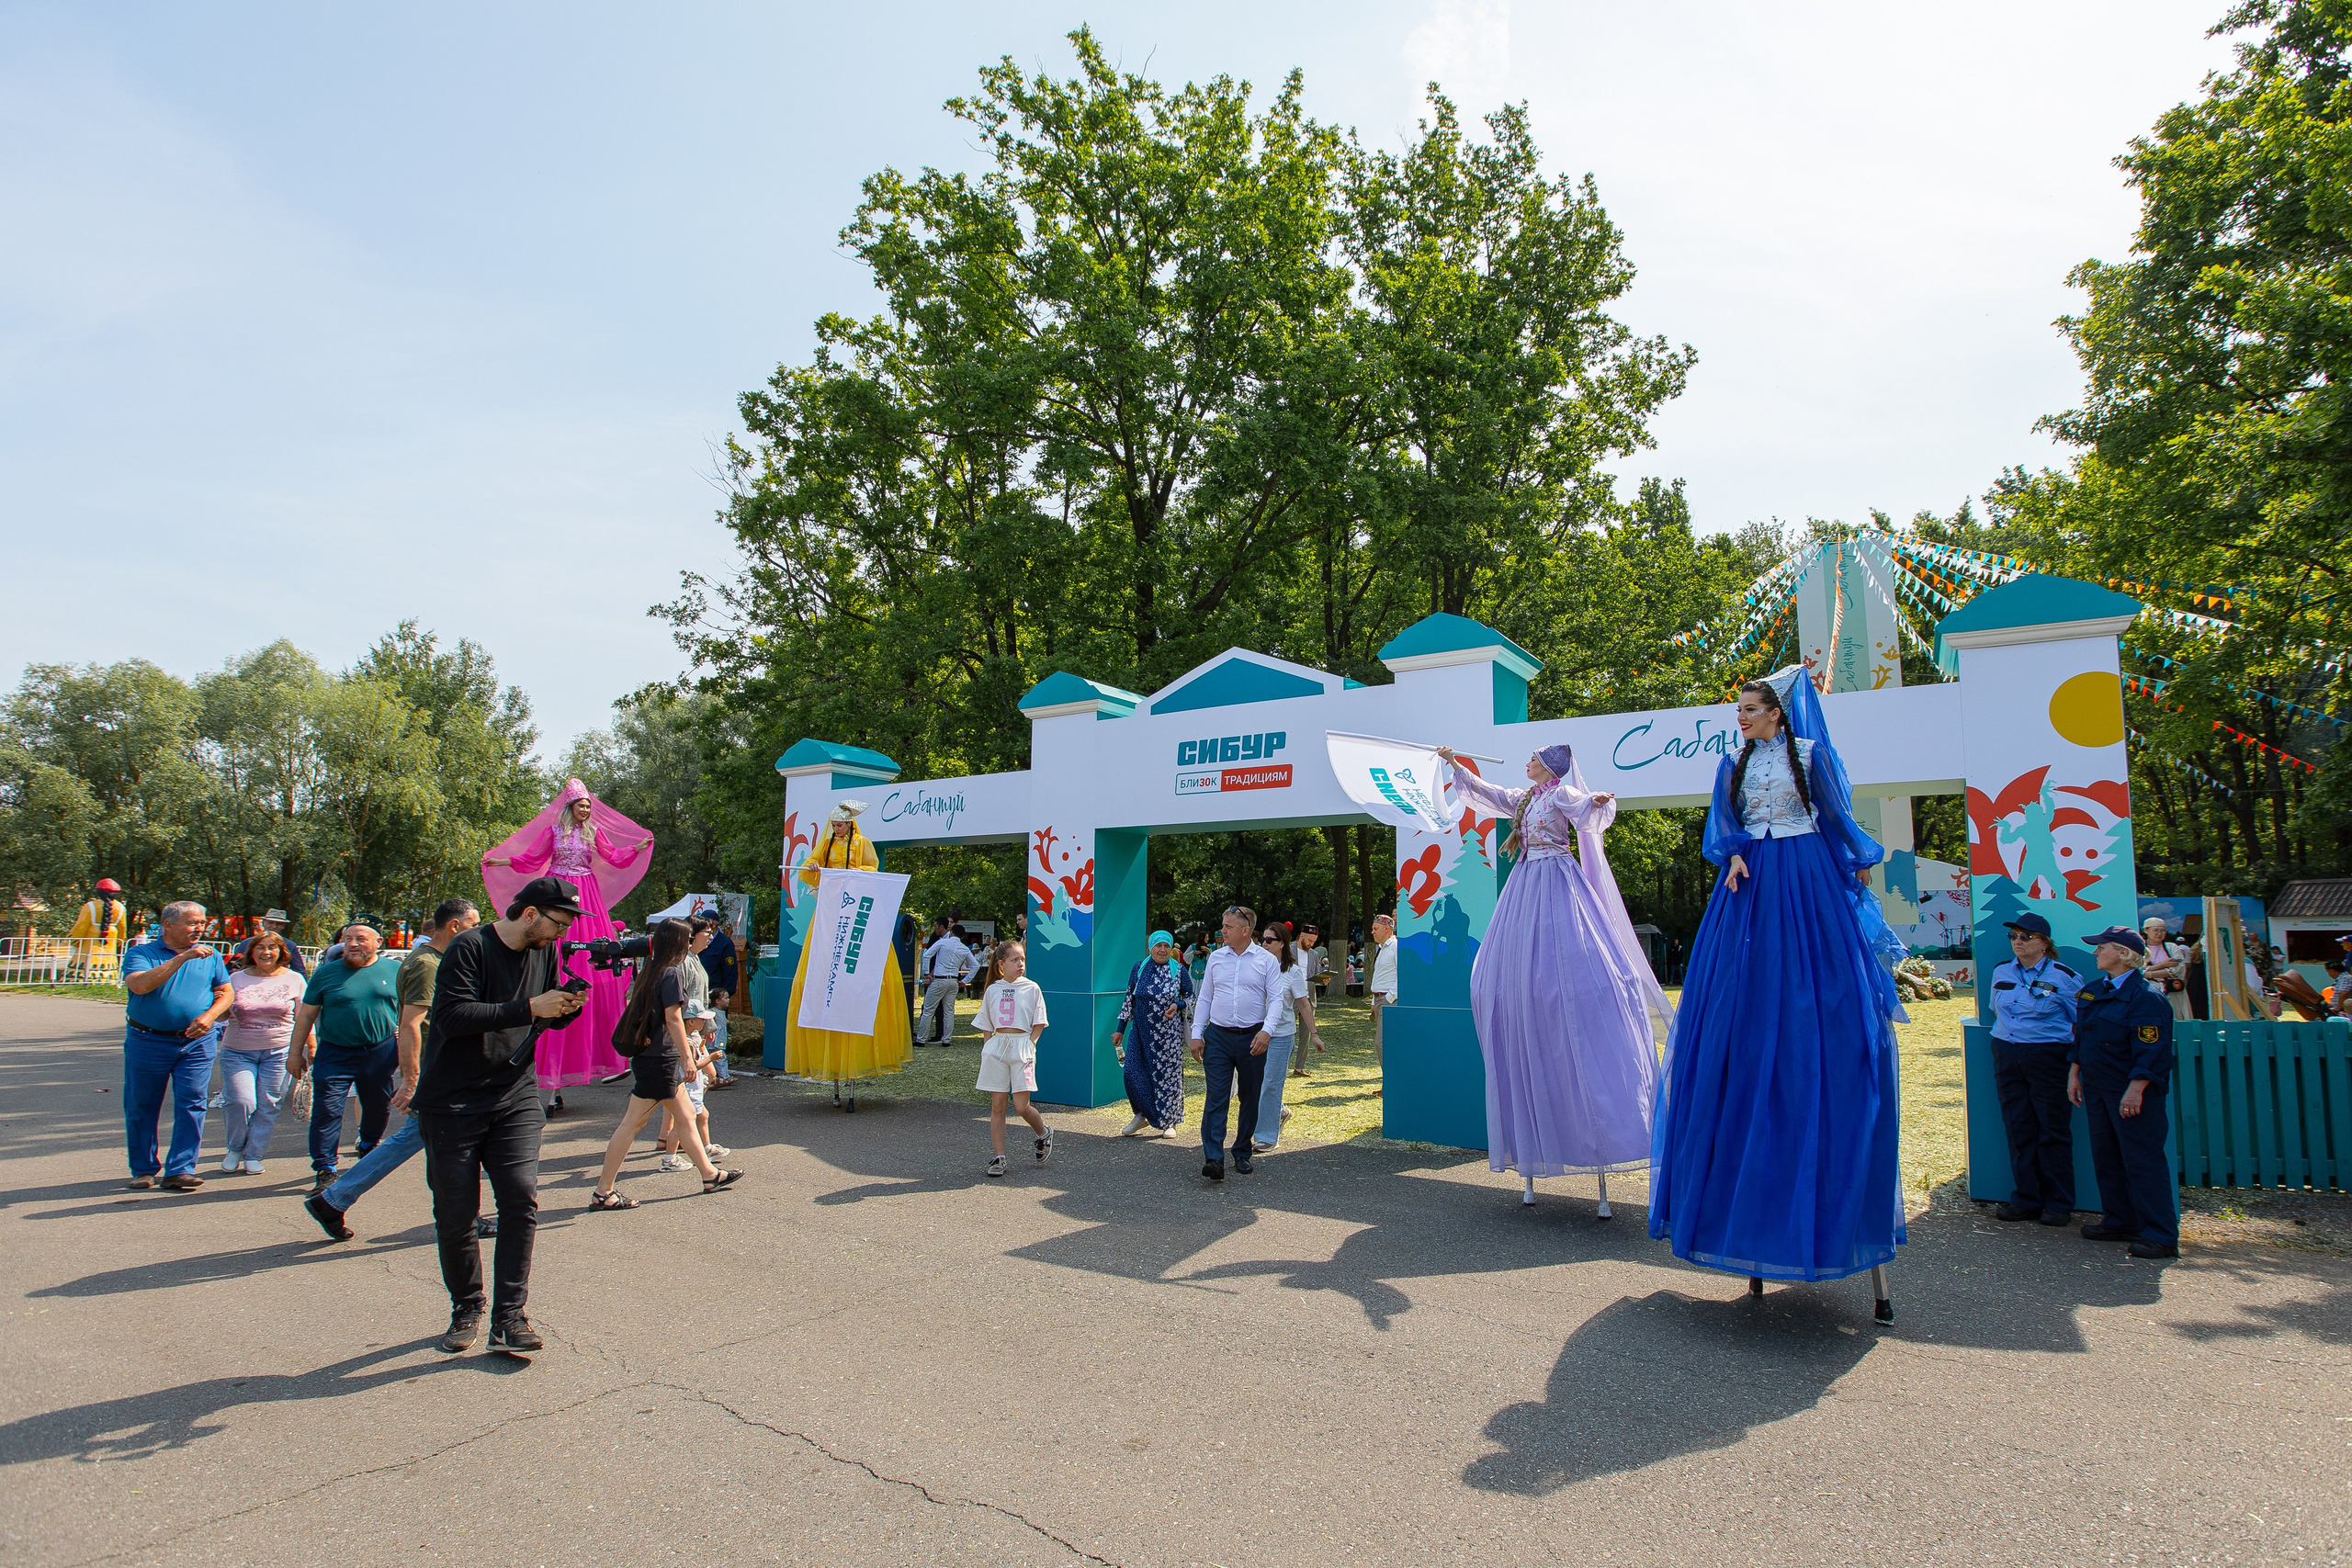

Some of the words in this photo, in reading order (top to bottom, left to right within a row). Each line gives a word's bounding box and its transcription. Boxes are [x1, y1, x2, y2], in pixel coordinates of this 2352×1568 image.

[1177, 731, 1286, 766] СИБУР
[1612, 718, 1739, 771] Сабан
[1224, 771, 1288, 785] ТРАДИЦИЯМ
[881, 788, 967, 831] Сабантуй
[843, 896, 875, 975] СИБУР
[826, 916, 852, 1008] НИЖНЕКАМСК
[999, 1000, 1015, 1026] 9
